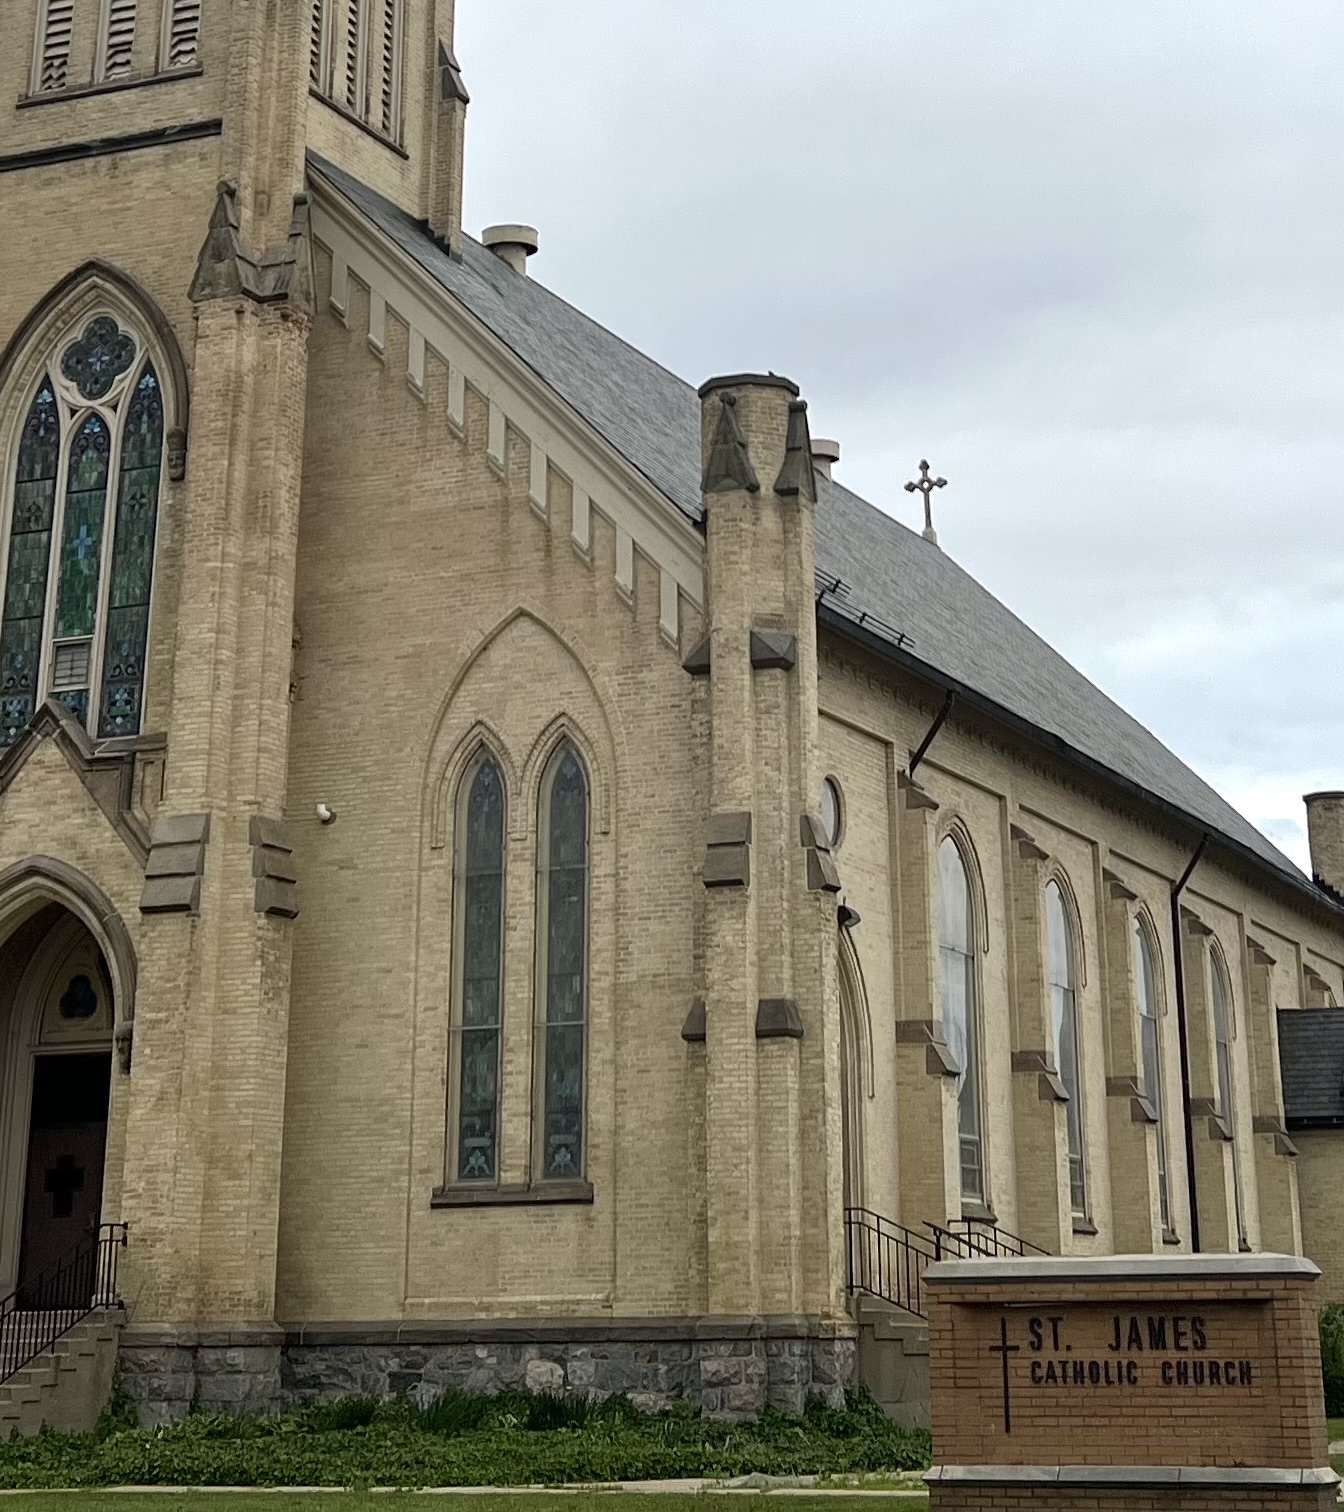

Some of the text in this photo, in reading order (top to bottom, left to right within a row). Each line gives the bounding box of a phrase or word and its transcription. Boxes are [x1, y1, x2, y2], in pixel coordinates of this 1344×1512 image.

[1028, 1315, 1207, 1352] ST. JAMES
[1030, 1360, 1253, 1386] CATHOLIC CHURCH
